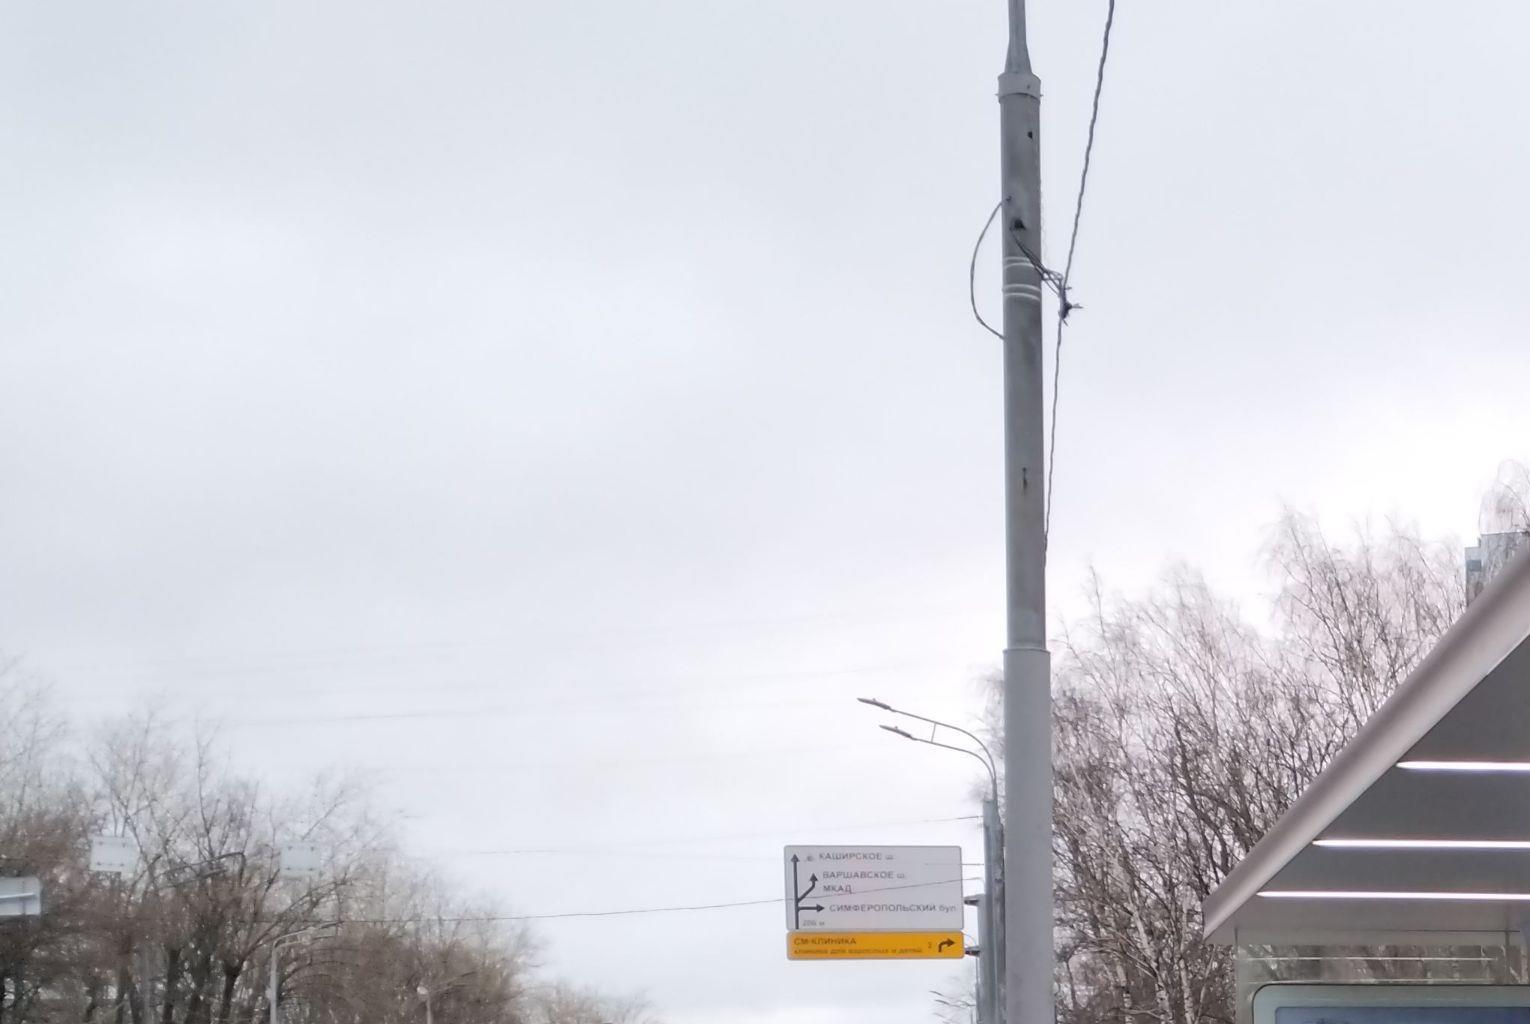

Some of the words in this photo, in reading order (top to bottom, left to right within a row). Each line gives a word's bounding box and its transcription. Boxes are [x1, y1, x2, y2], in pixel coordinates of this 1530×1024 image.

[819, 852, 882, 861] КАШИРСКОЕ
[822, 871, 894, 879] ВАРШАВСКОЕ
[823, 884, 852, 894] МКАД
[829, 903, 937, 912] СИМФЕРОПОЛЬСКИЙ
